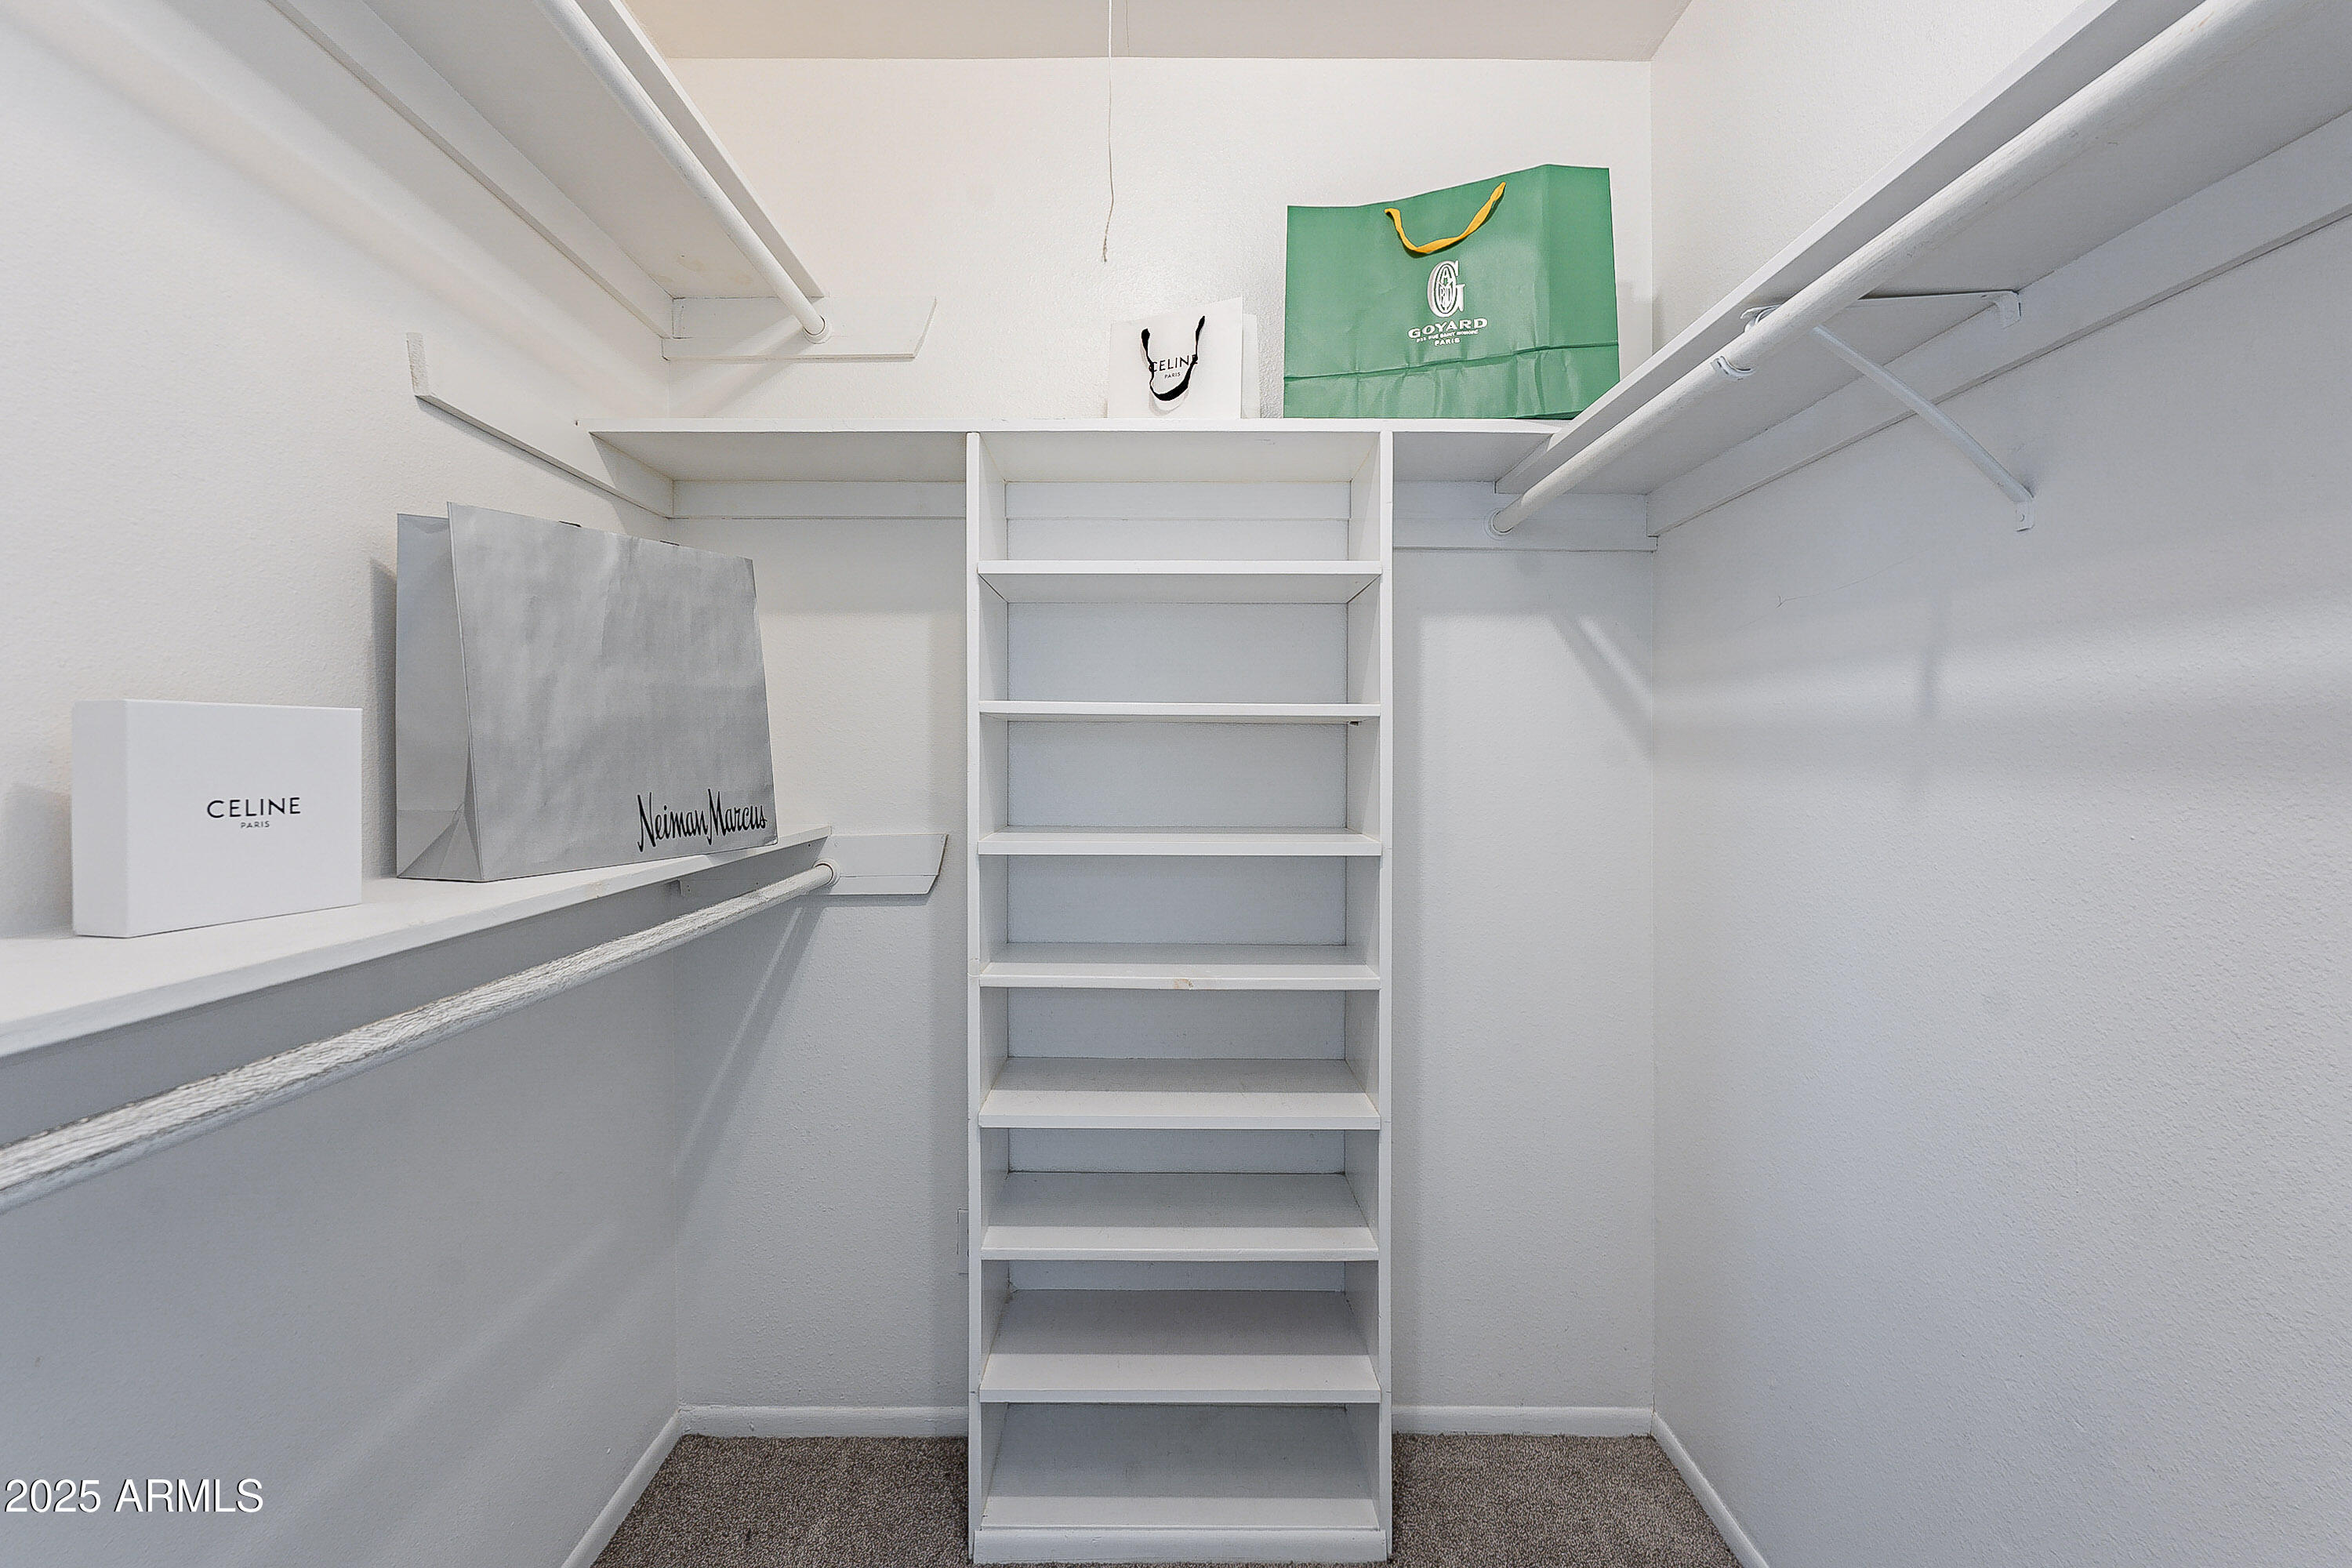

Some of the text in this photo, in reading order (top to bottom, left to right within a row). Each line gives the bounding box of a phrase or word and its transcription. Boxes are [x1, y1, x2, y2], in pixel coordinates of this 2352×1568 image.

[1407, 318, 1488, 339] GOYARD
[1434, 337, 1461, 347] PARIS
[207, 797, 301, 818] CELINE
[240, 820, 270, 829] PARIS
[637, 788, 768, 853] Neiman Marcus
